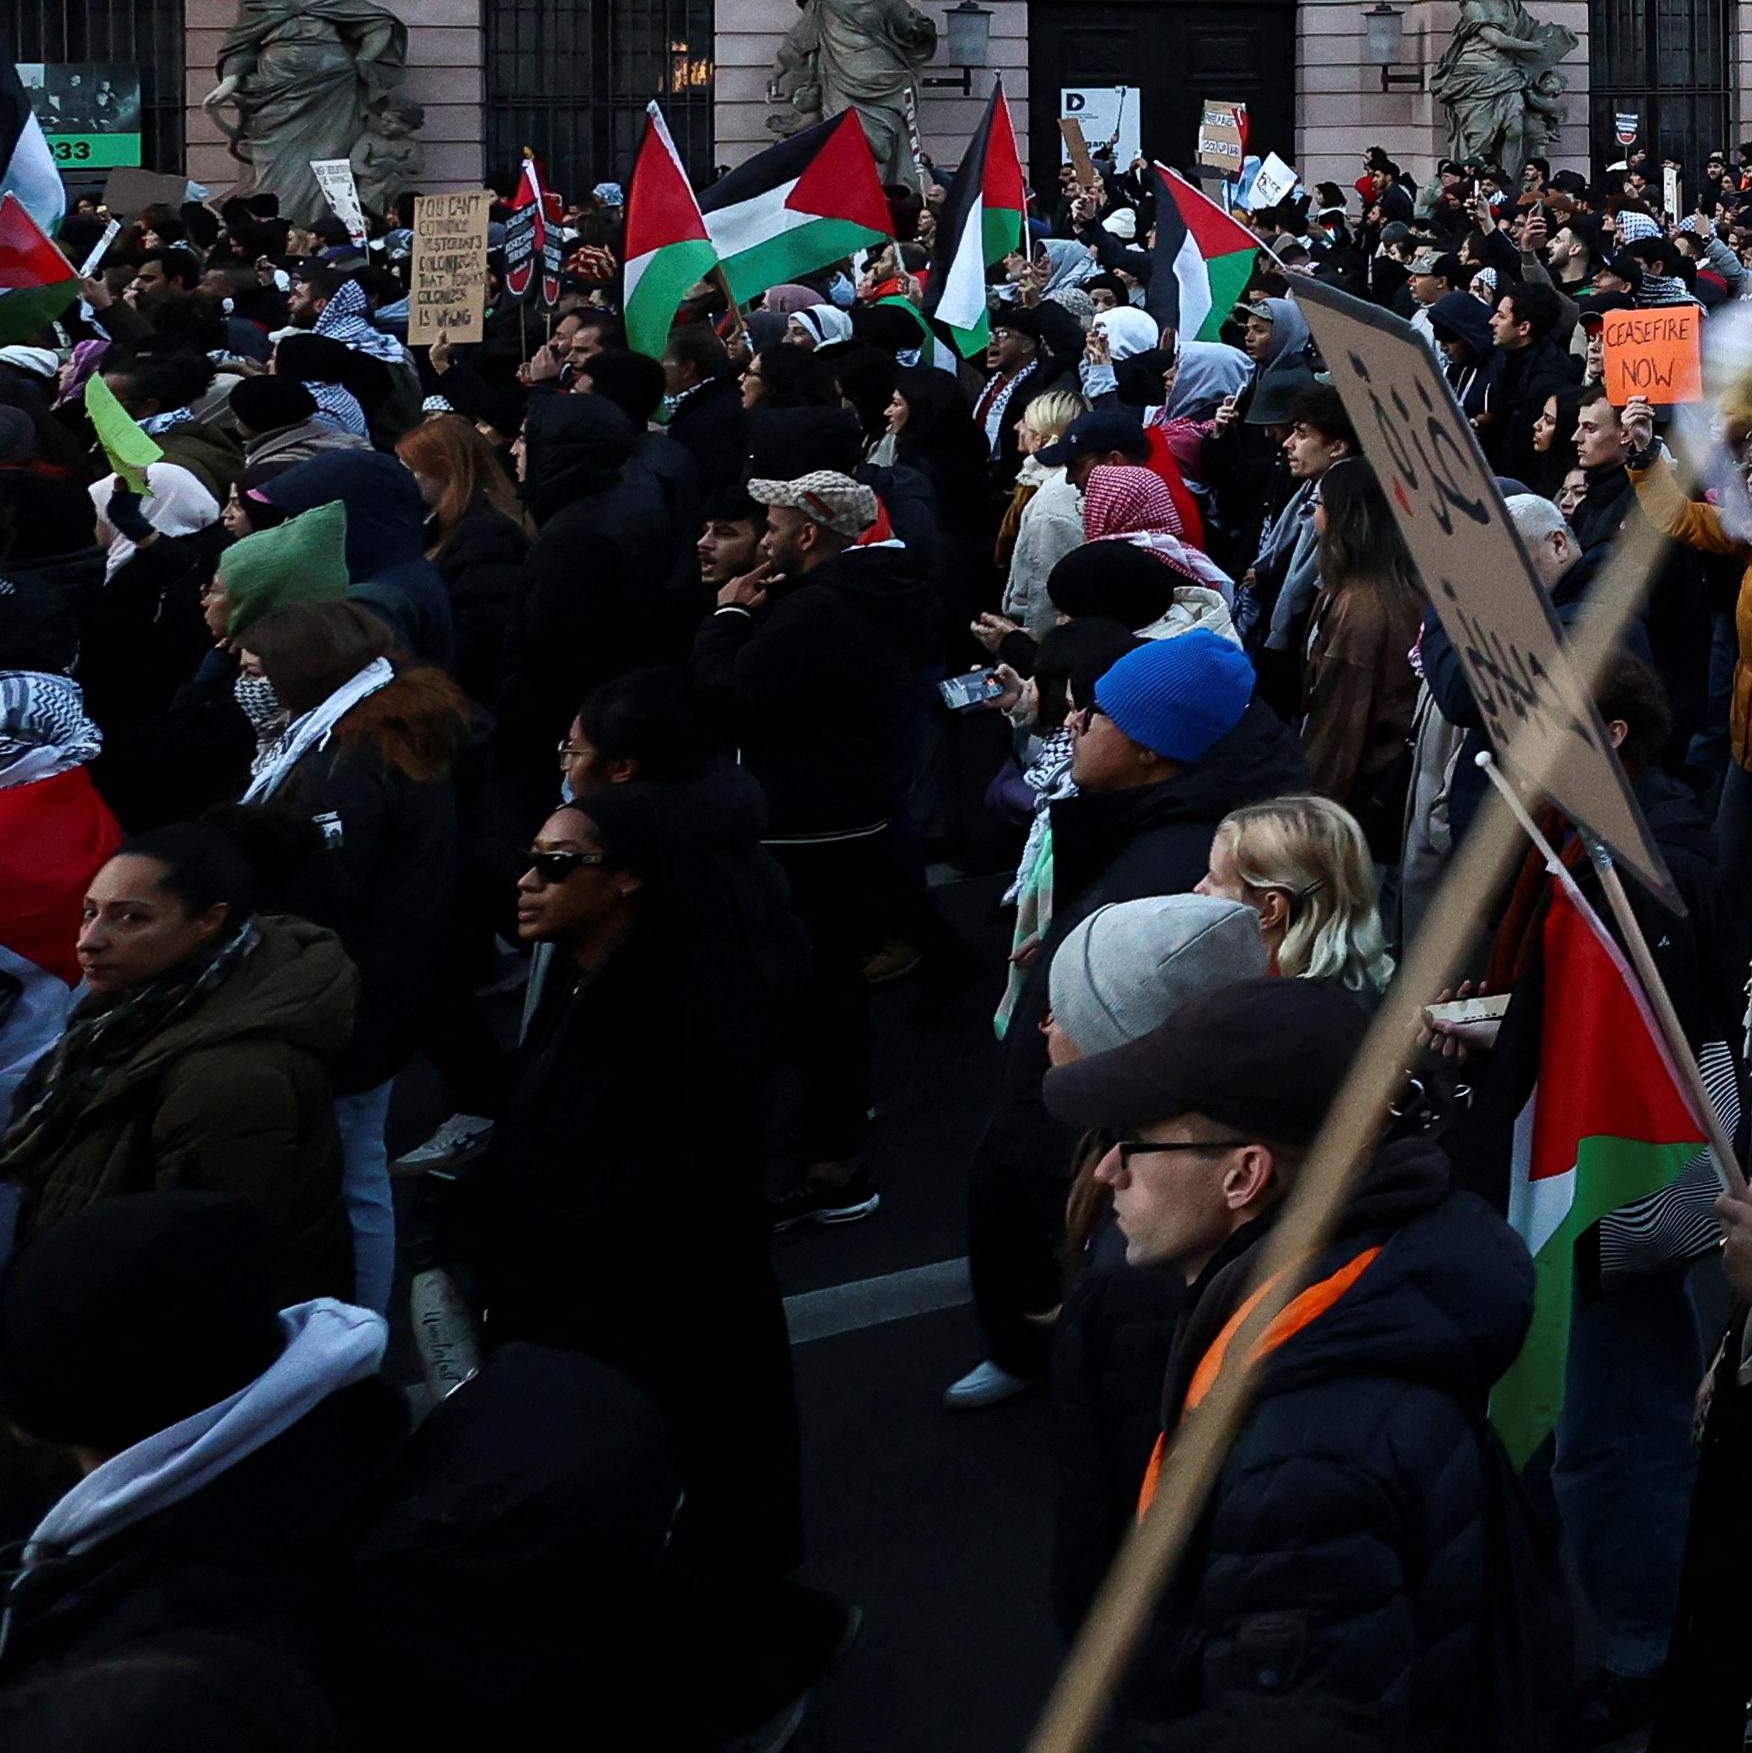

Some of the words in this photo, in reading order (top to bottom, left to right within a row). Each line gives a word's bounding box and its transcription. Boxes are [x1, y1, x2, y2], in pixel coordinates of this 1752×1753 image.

[48, 141, 91, 160] 33
[417, 197, 445, 218] YOU
[1606, 317, 1691, 347] CEASEFIRE
[1621, 357, 1676, 389] NOW
